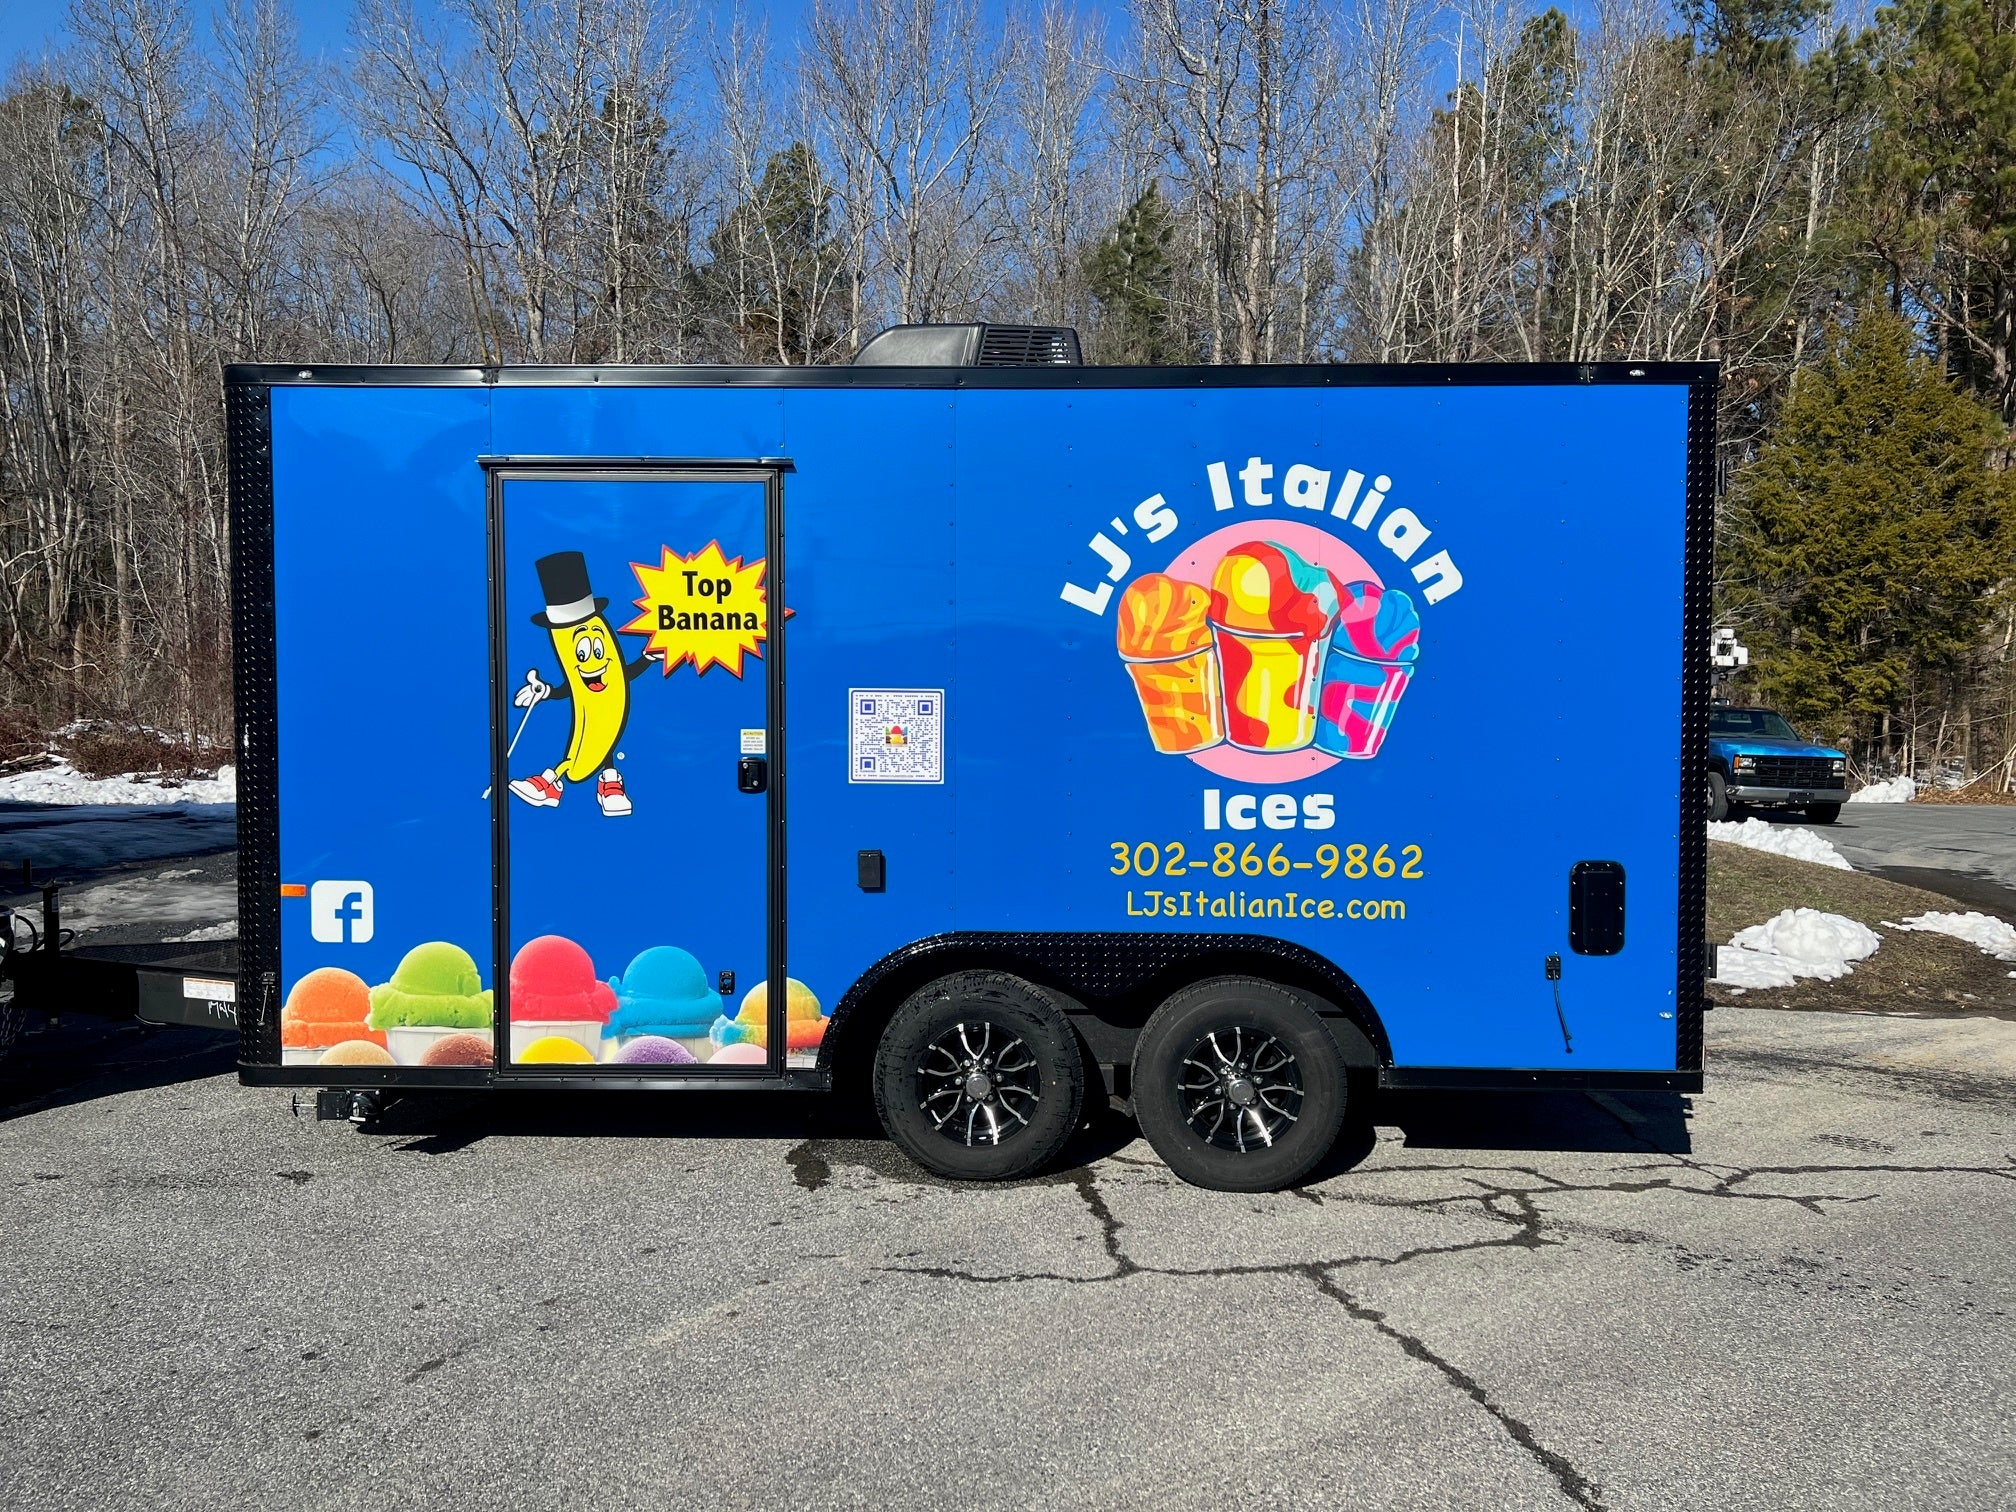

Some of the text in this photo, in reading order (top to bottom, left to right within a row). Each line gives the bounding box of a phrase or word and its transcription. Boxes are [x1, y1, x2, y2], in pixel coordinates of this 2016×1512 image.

[1060, 457, 1463, 616] LJ's Italian
[682, 571, 732, 604] Top
[658, 605, 758, 630] Banana
[1203, 789, 1336, 830] Ices
[1110, 841, 1424, 879] 302-866-9862
[1127, 891, 1406, 919] LJsItalianIce.com
